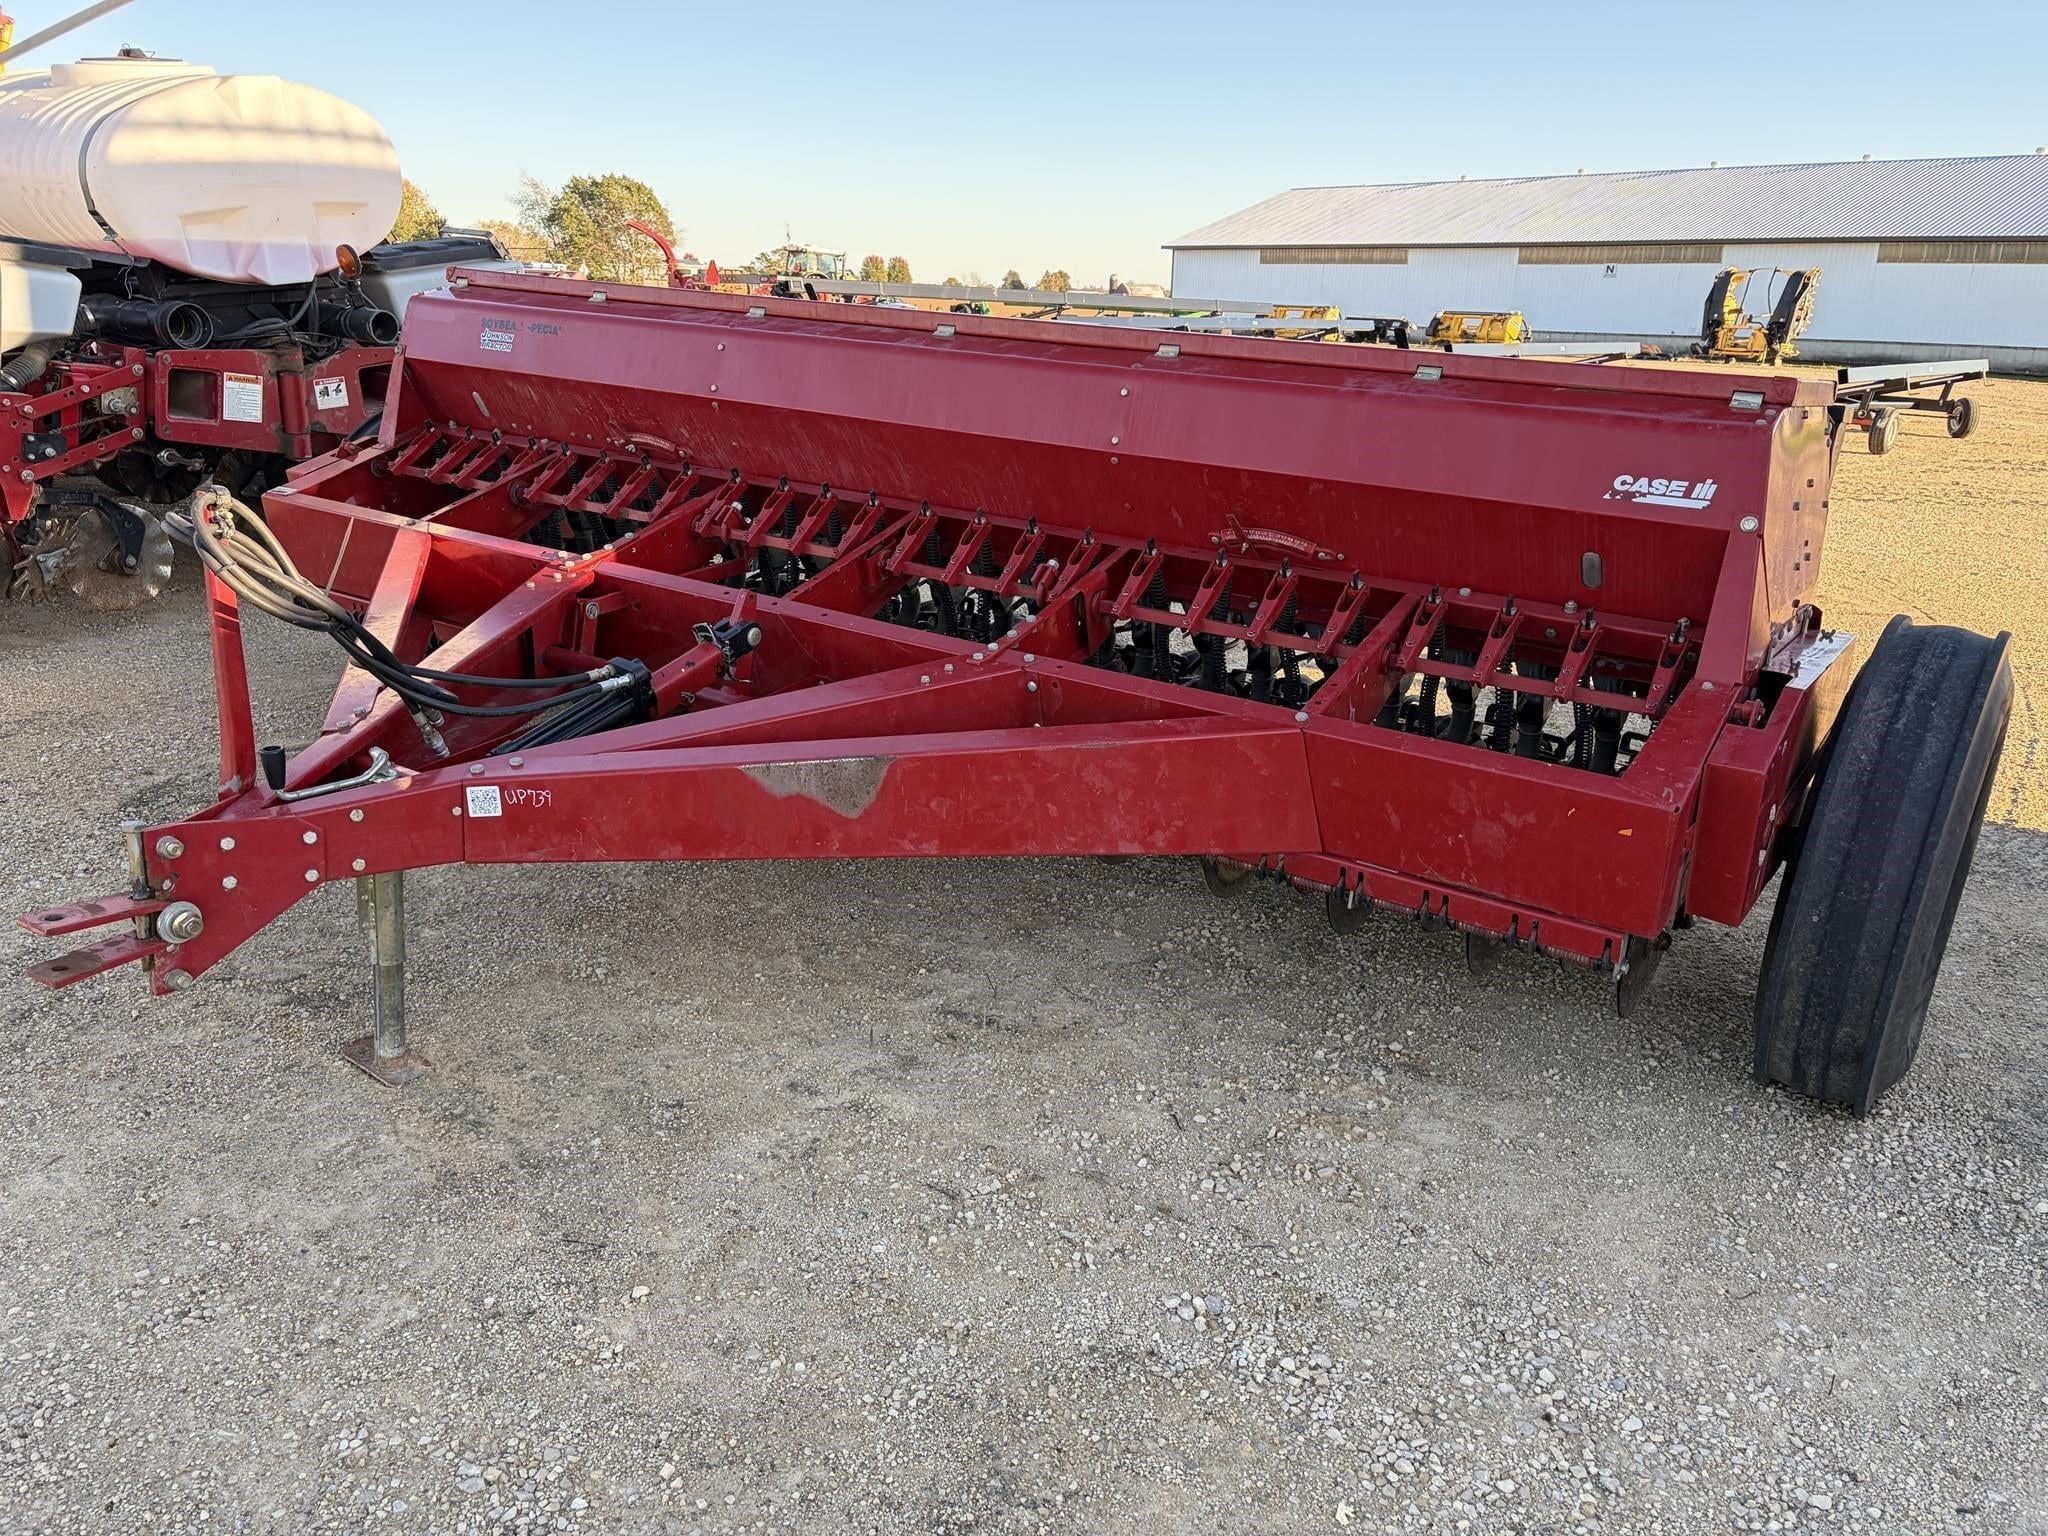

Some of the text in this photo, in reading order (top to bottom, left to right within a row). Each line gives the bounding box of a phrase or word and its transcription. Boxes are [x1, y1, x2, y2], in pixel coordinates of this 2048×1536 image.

[1605, 264, 1615, 274] N
[481, 318, 562, 336] SOYBEA PECIA
[481, 328, 514, 342] JOHNSON
[480, 340, 512, 352] TRACTOR
[1613, 475, 1689, 496] CASE
[504, 789, 551, 808] UP739
